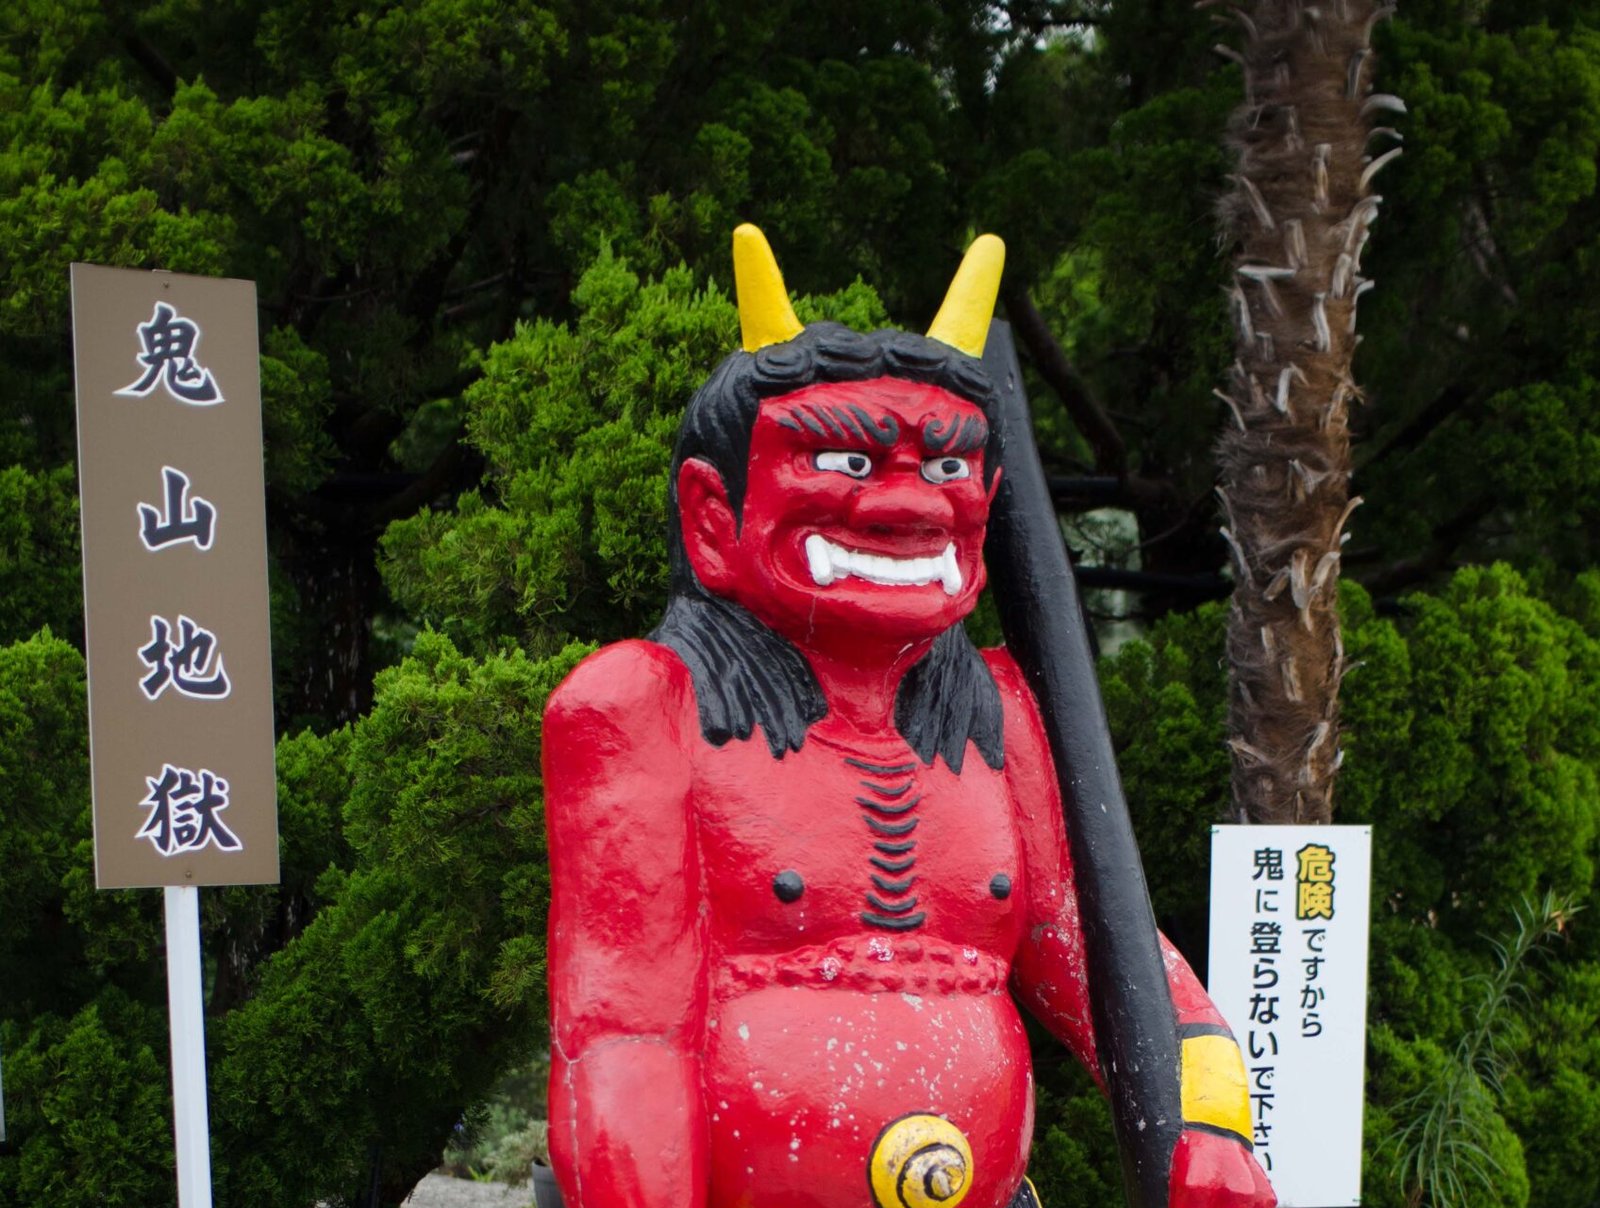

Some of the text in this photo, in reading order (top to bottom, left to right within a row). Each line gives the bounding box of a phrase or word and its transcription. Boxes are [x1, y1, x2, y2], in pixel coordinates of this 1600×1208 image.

[112, 300, 243, 856] 鬼山地獄
[1296, 843, 1335, 1038] 危険ですから
